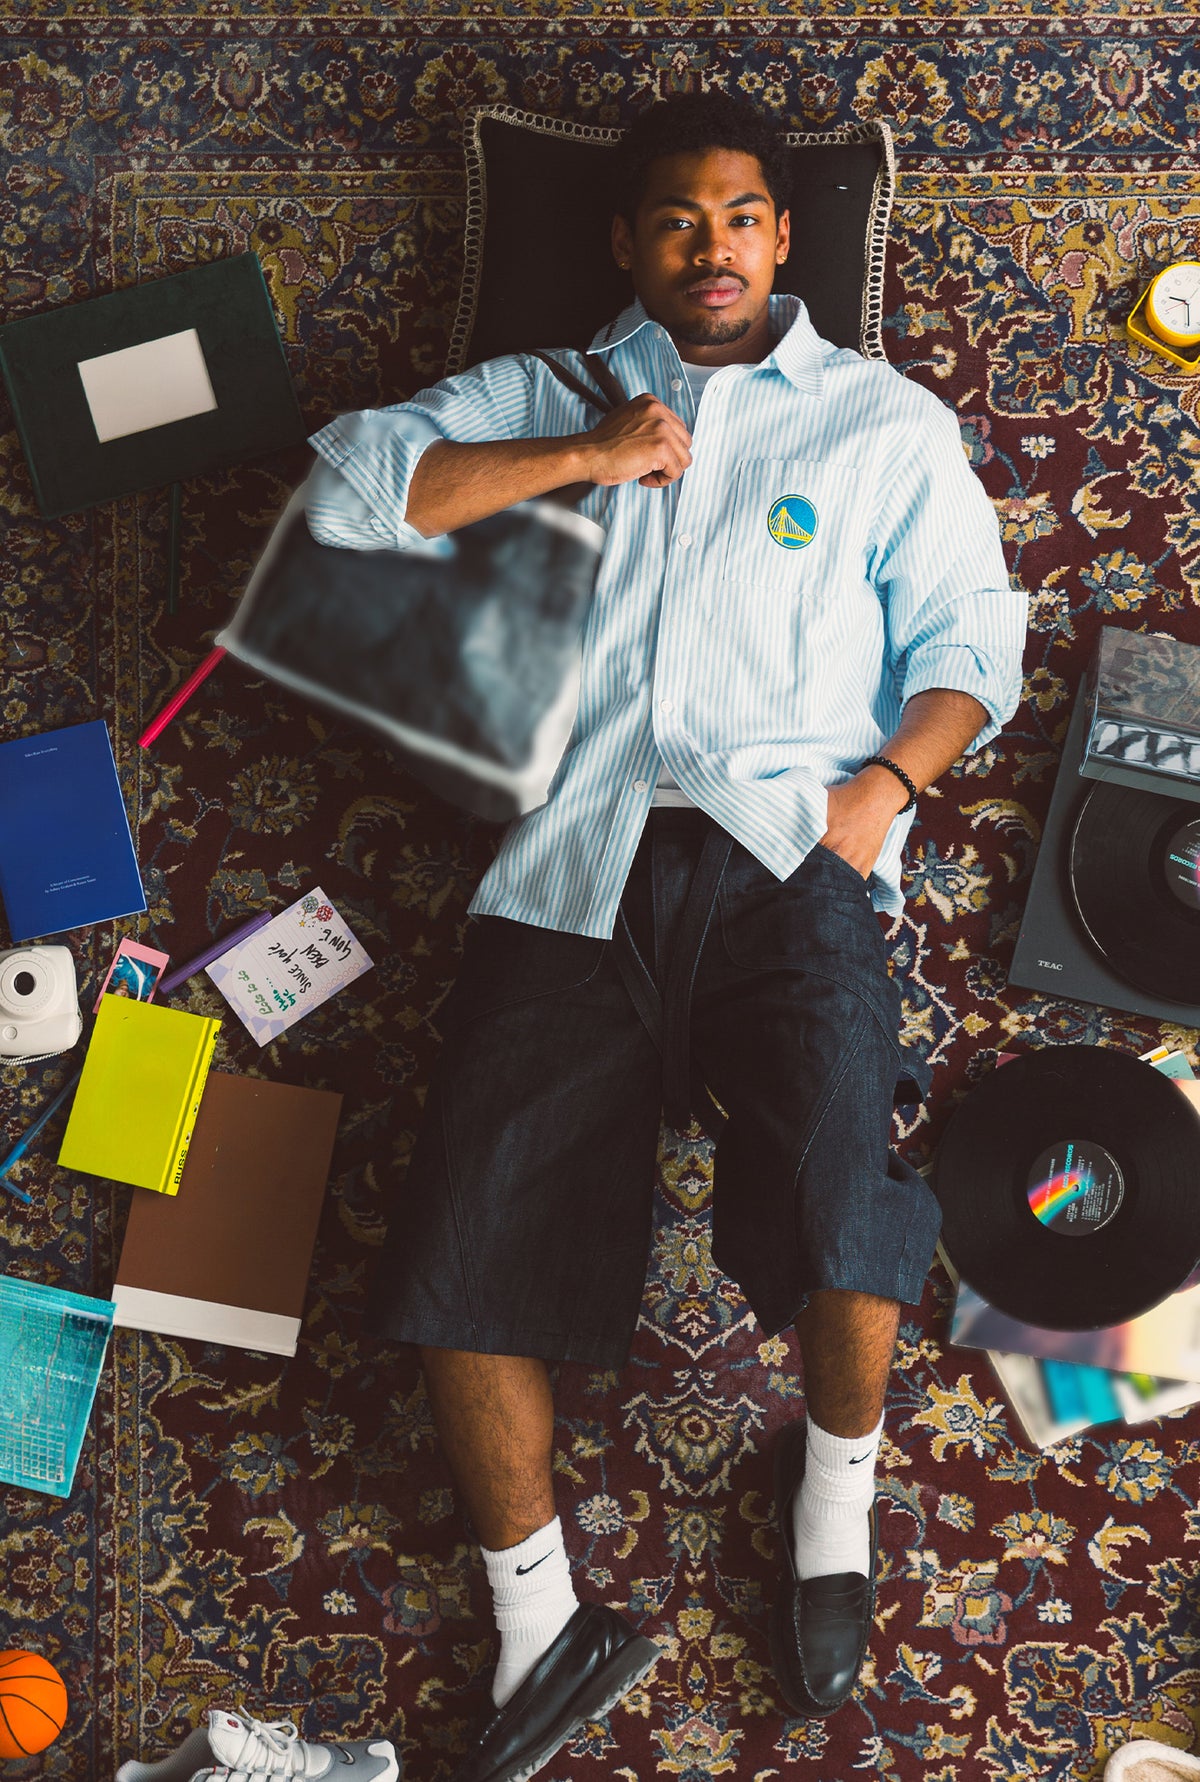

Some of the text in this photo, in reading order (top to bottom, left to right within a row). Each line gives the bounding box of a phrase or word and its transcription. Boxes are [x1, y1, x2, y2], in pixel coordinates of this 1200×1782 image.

[300, 943, 330, 969] BEEN
[1037, 959, 1064, 971] TEAC
[238, 970, 274, 1015] Lots to do
[287, 963, 312, 994] SINCE
[282, 988, 297, 1007] bye
[1064, 1144, 1074, 1174] RECORDS
